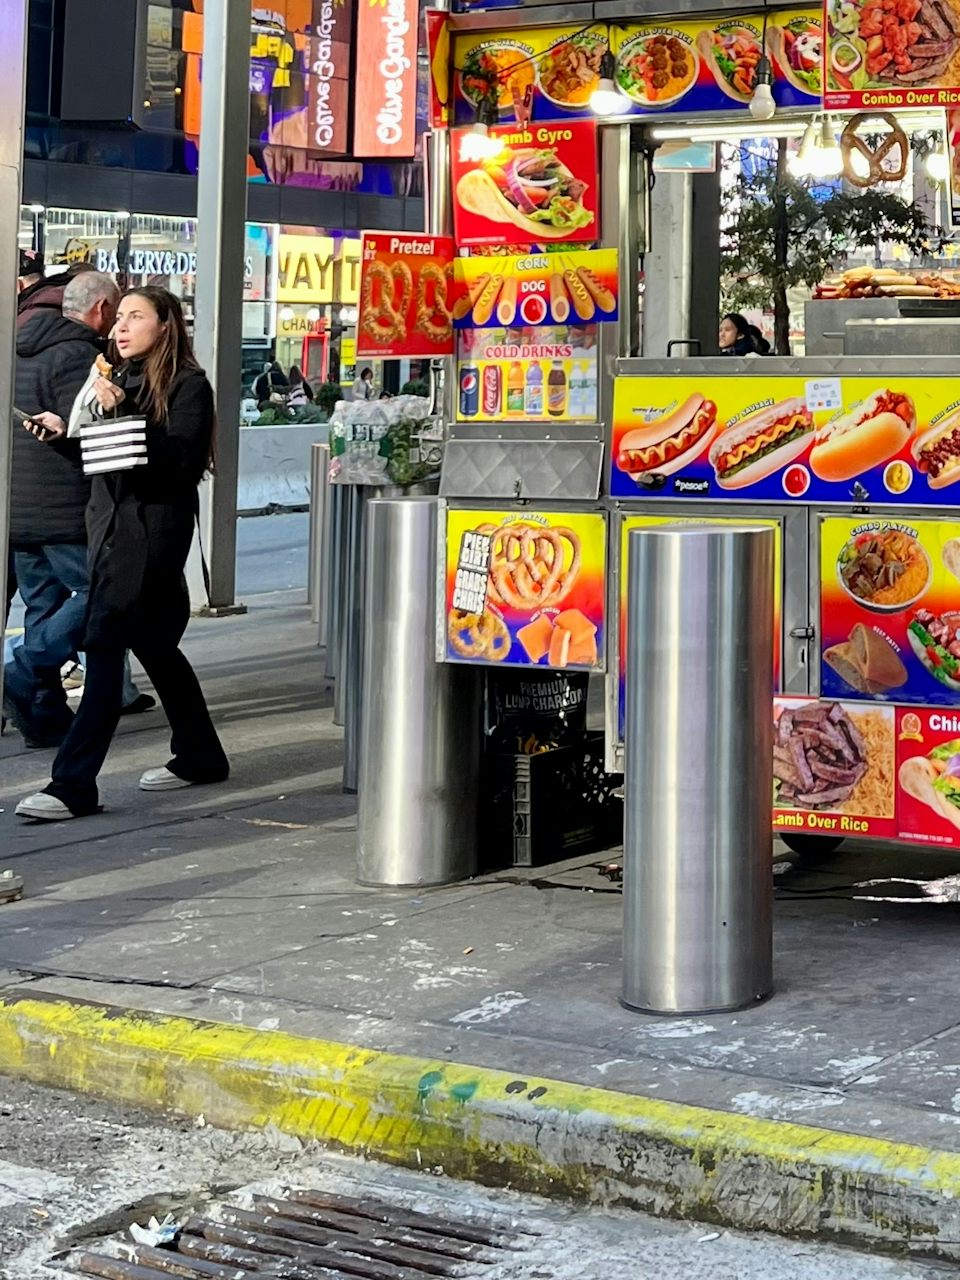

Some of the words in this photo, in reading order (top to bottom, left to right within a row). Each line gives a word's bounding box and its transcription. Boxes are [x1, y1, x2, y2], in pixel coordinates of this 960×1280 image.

[652, 27, 673, 36] OVER
[674, 30, 694, 46] RICE
[861, 92, 903, 105] Combo
[906, 91, 935, 104] Over
[377, 74, 406, 144] Olive
[537, 128, 573, 145] Gyro
[390, 238, 435, 255] Pretzel
[516, 256, 551, 271] CORN
[521, 280, 546, 293] DOG
[485, 345, 519, 359] COLD
[520, 344, 573, 358] DRINKS
[741, 398, 775, 418] SAUSAGE
[850, 522, 880, 537] COMBO
[883, 521, 918, 539] PLATTER
[520, 678, 569, 698] PREMIUM
[808, 814, 838, 829] Over
[840, 816, 869, 832] Rice
